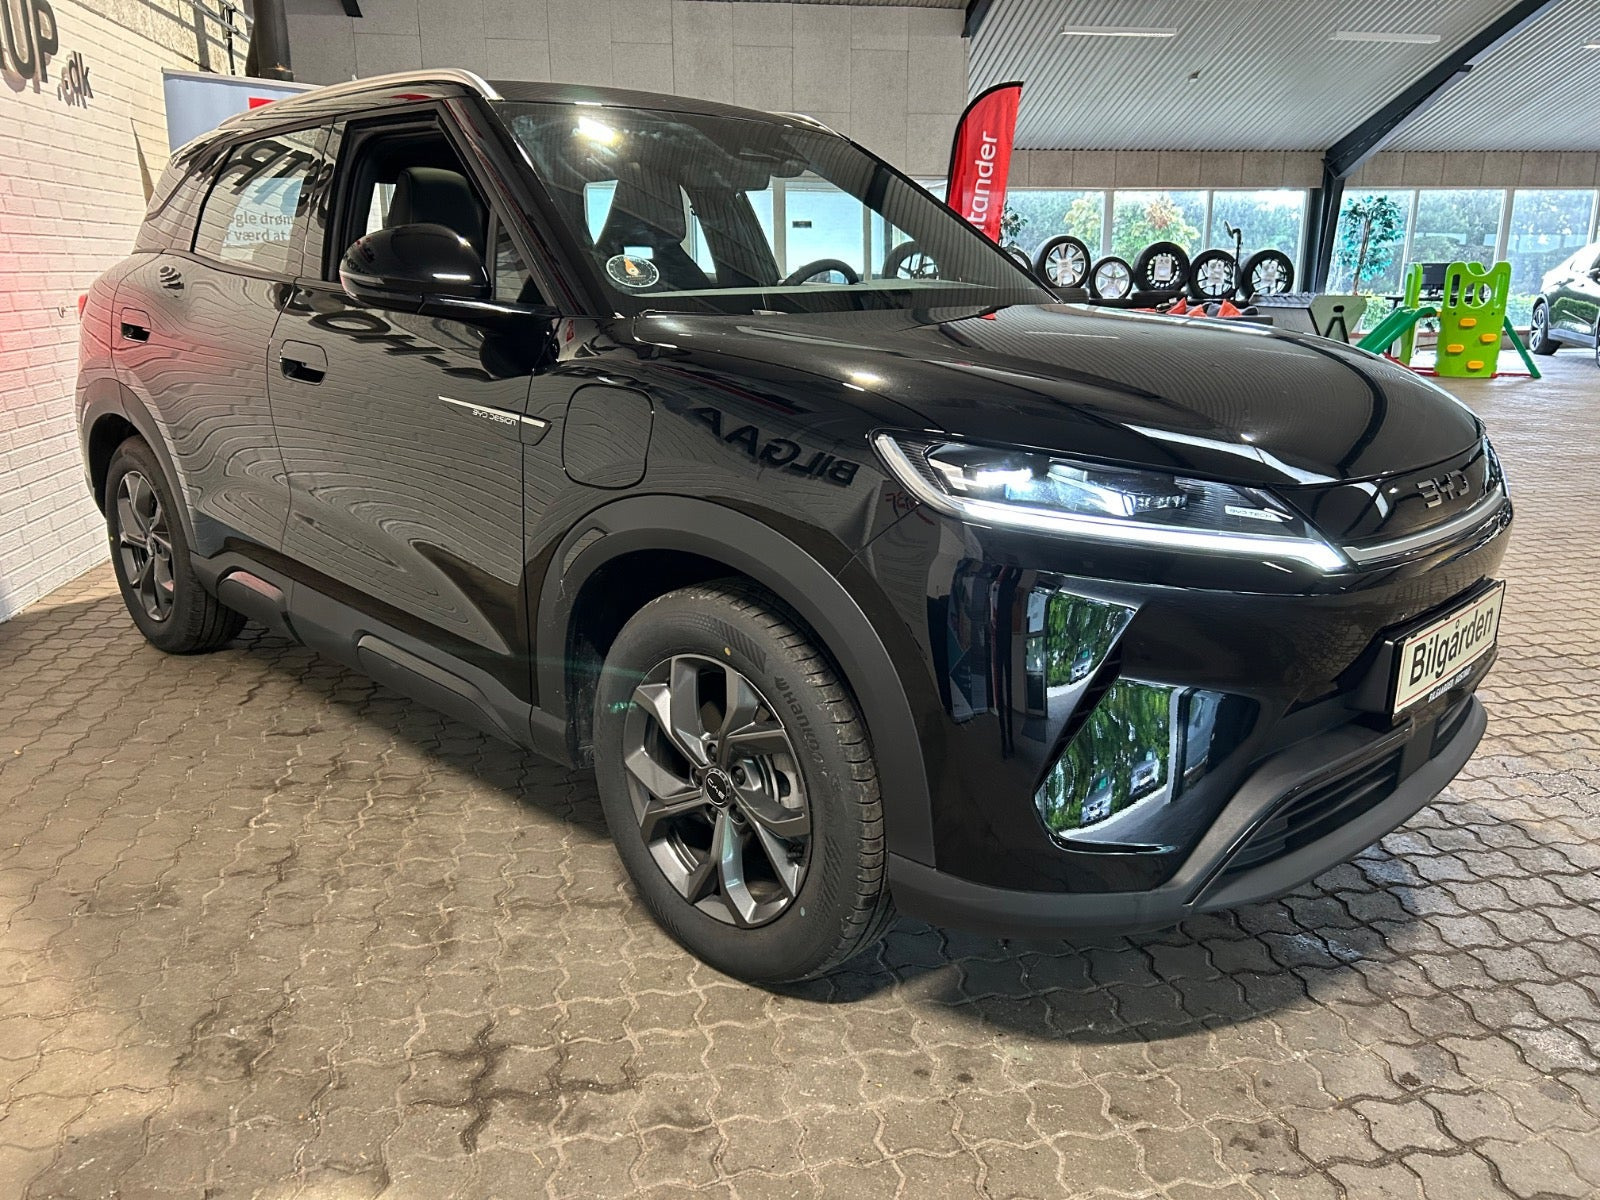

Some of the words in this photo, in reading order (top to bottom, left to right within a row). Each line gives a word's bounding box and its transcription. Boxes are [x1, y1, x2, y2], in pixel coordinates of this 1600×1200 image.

[0, 0, 58, 83] UP
[231, 211, 257, 228] gle
[234, 229, 270, 241] værd
[273, 230, 287, 241] at
[489, 413, 517, 427] DESIGN
[1415, 470, 1470, 508] BYD
[1409, 608, 1493, 687] Bilgården
